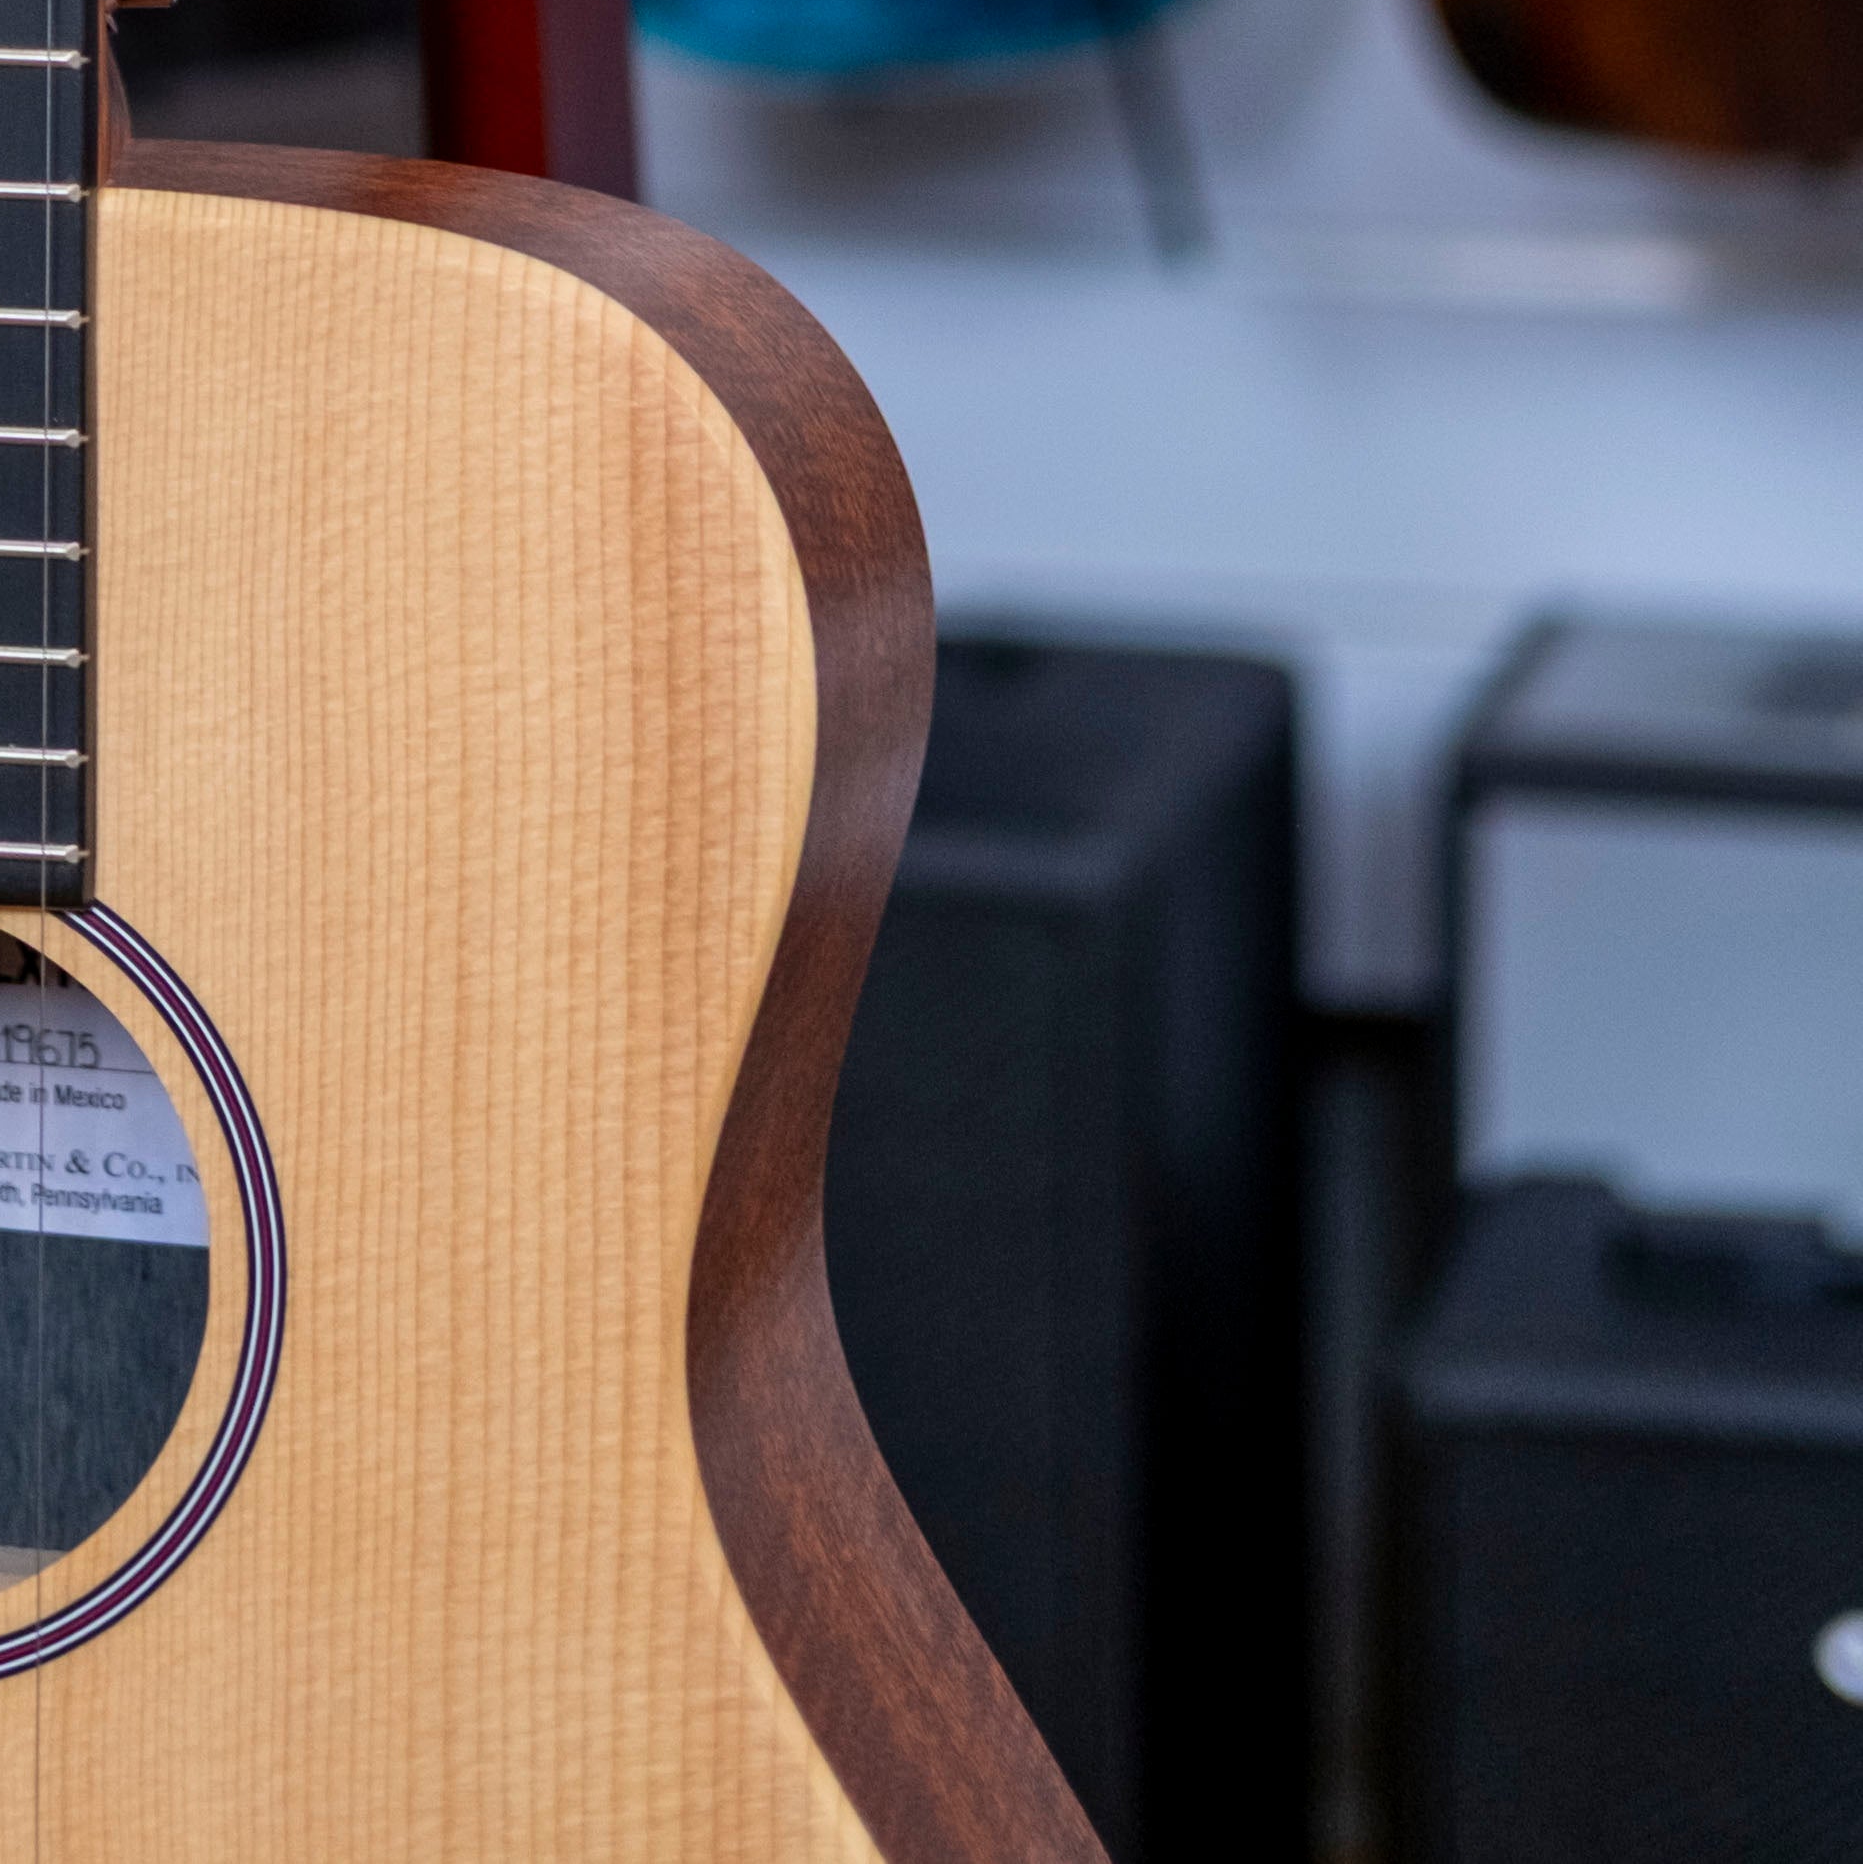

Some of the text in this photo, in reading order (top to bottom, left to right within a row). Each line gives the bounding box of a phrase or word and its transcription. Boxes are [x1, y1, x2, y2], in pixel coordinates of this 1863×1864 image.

[29, 1082, 47, 1104] in
[54, 1083, 127, 1110] Mexico
[64, 1148, 90, 1175] &
[31, 1182, 163, 1215] Pennsylvania
